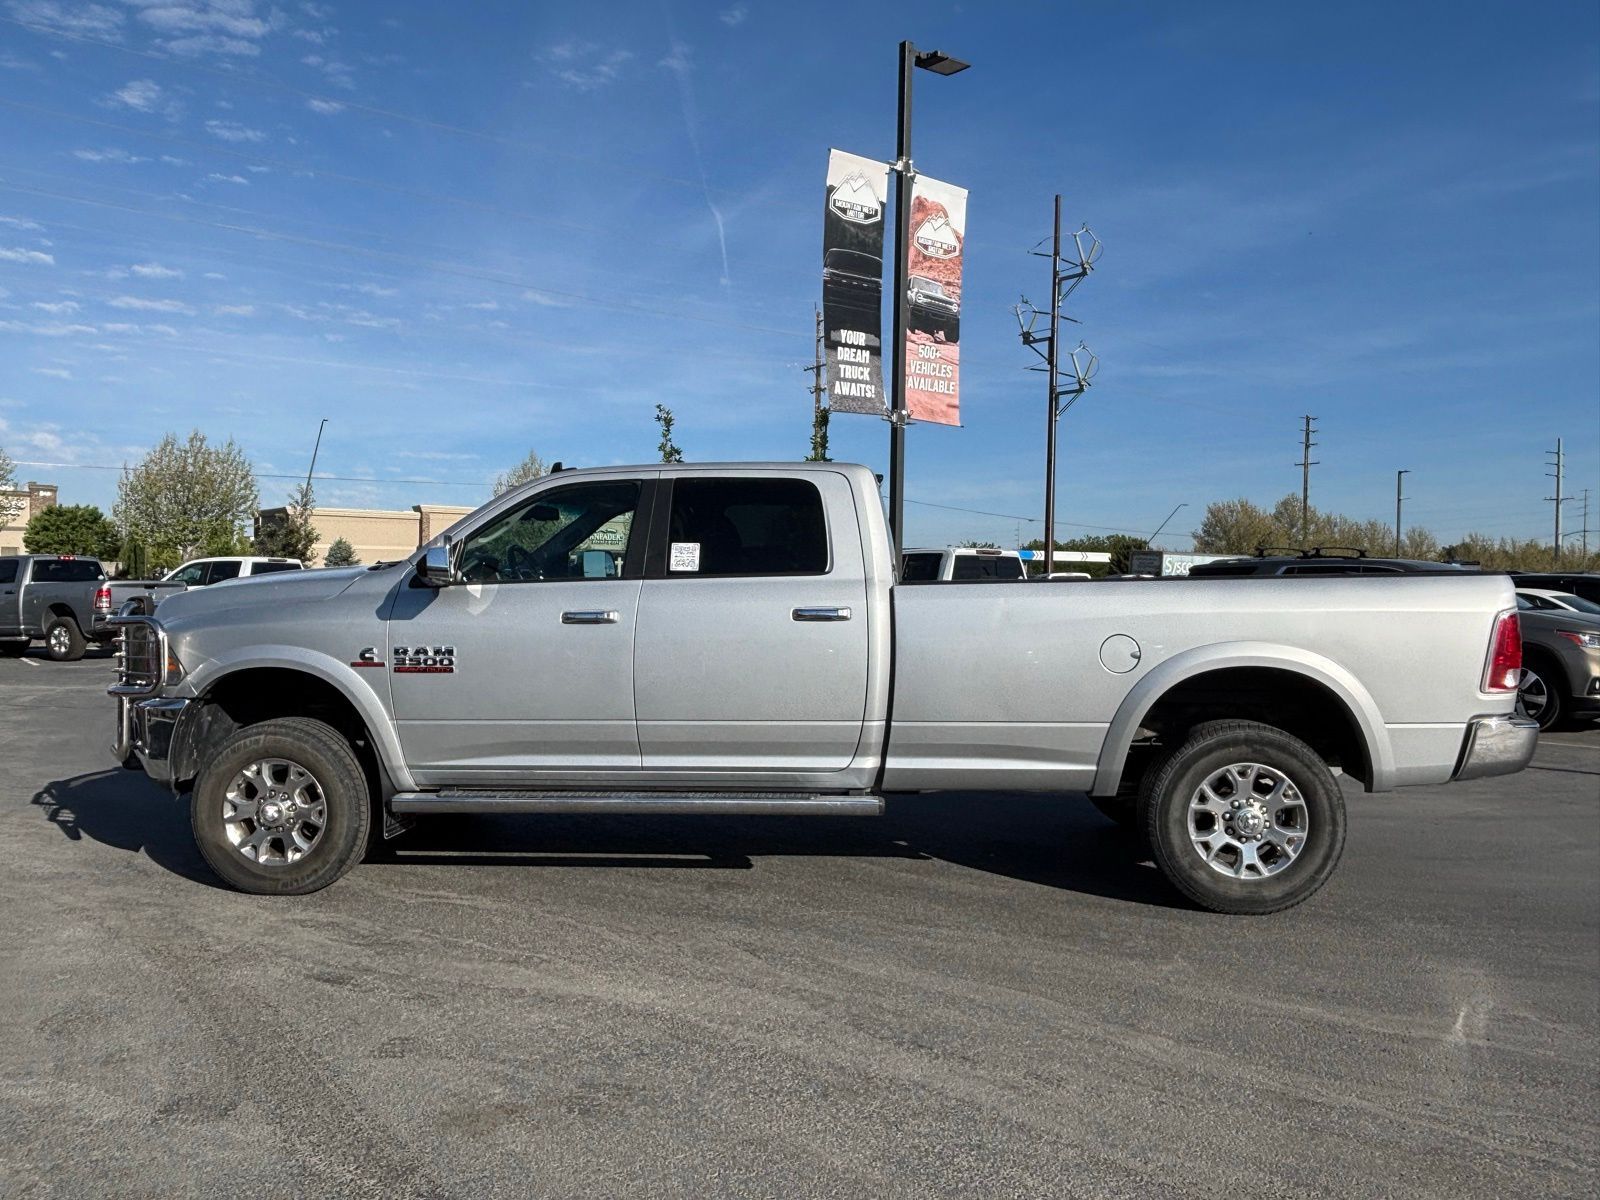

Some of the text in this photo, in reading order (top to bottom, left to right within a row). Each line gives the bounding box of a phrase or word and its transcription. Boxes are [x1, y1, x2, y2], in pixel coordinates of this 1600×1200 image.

[835, 199, 876, 215] MOUNTAIN WEST
[846, 209, 864, 220] MOTOR
[840, 329, 866, 346] YOUR
[837, 346, 870, 364] DREAM
[918, 345, 941, 359] 500+
[839, 364, 871, 381] TRUCK
[910, 360, 953, 378] VEHICLES
[834, 381, 875, 398] AWAITS!
[907, 376, 955, 394] AVAILABLE
[394, 646, 456, 656] RAM
[394, 657, 455, 666] 3500
